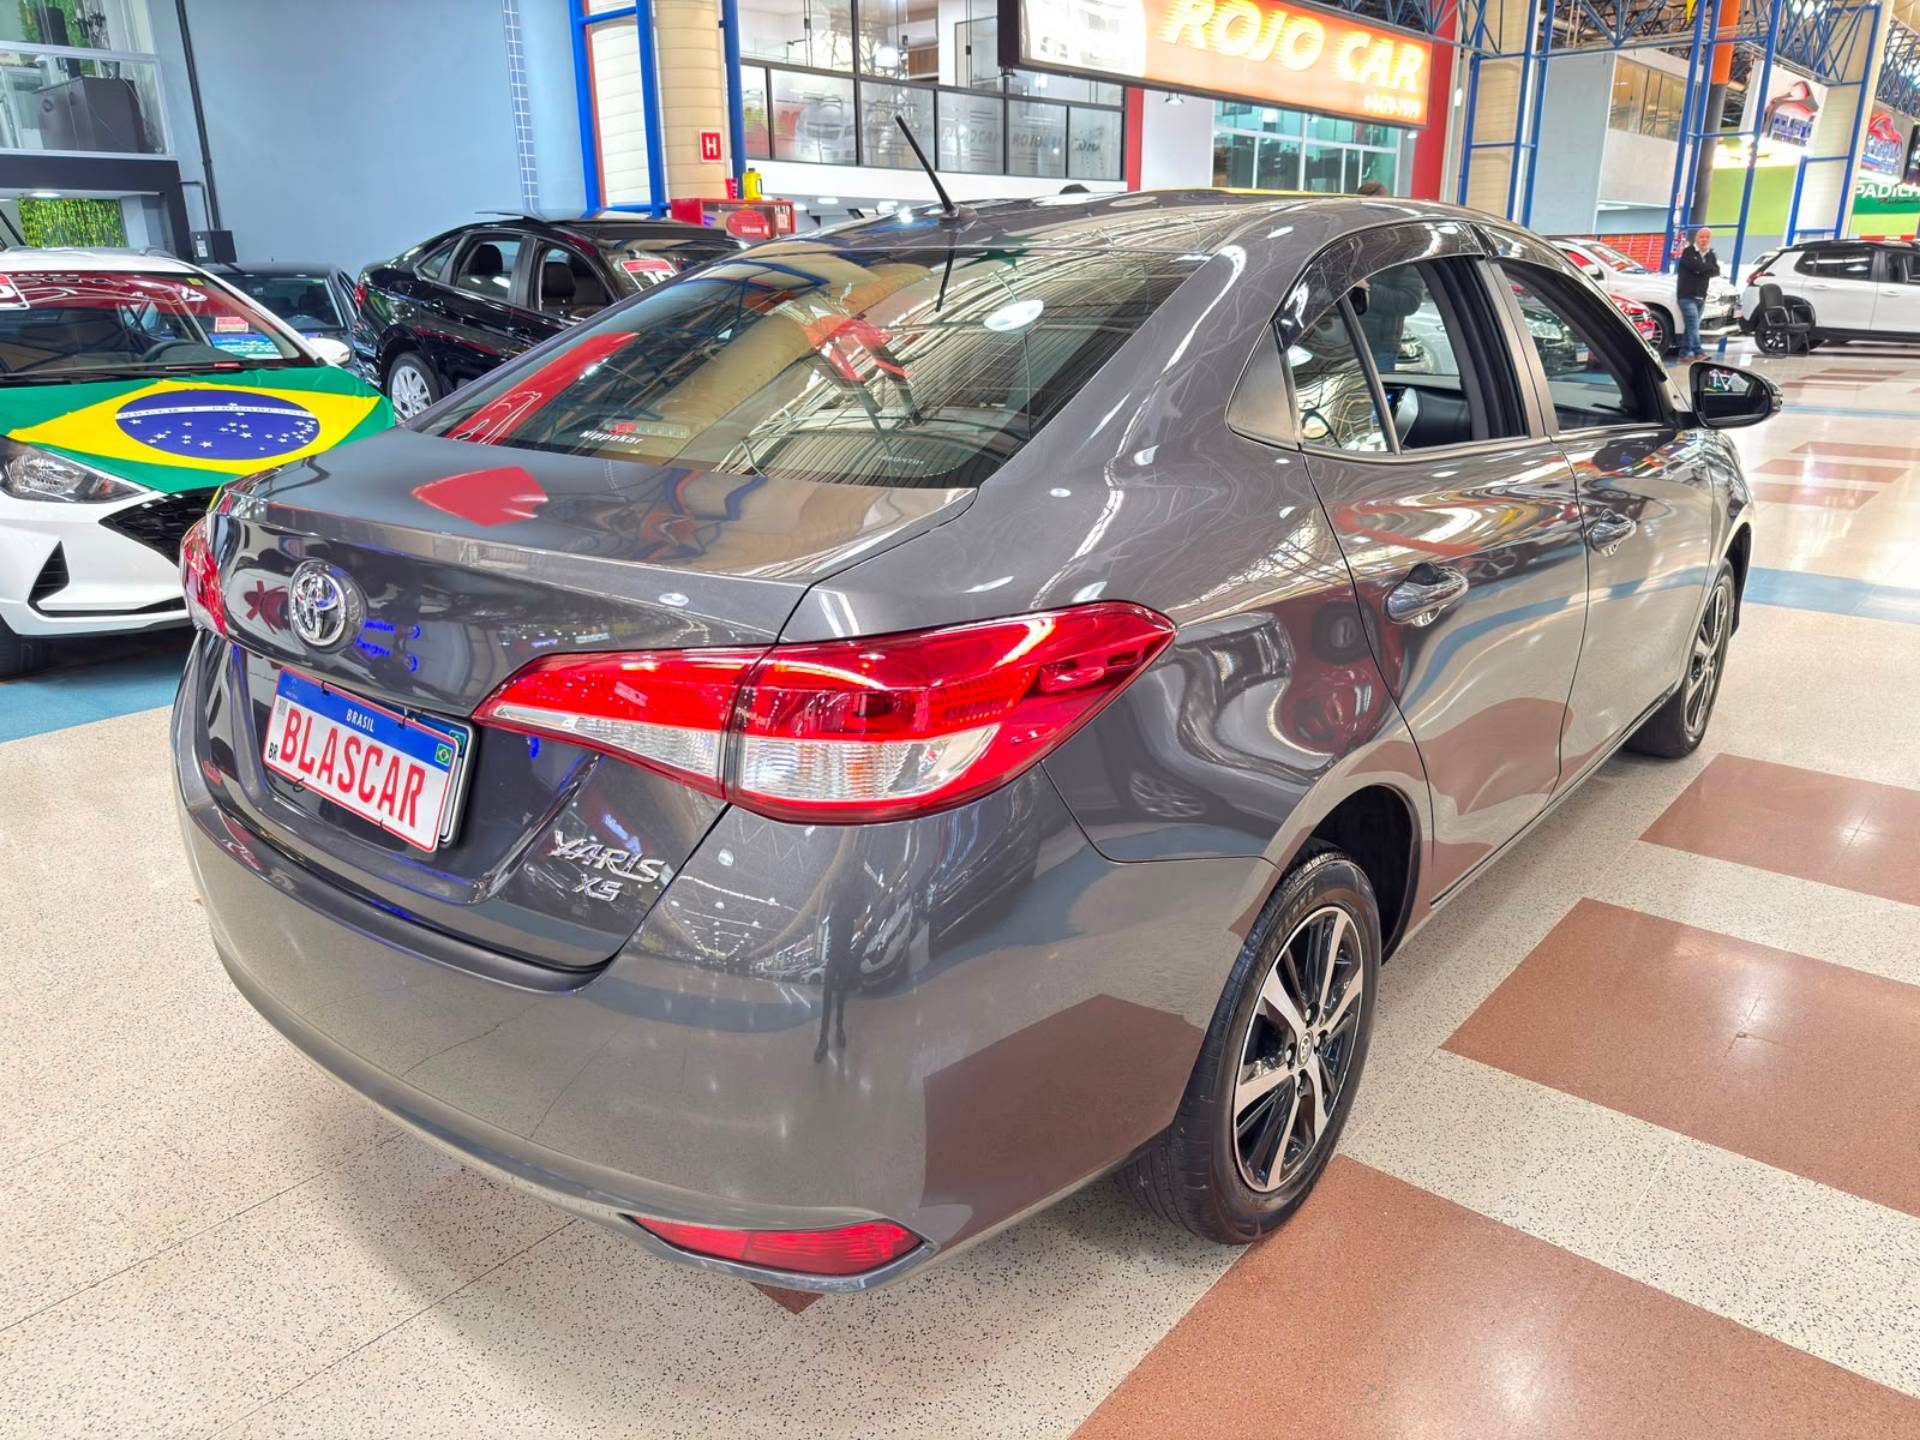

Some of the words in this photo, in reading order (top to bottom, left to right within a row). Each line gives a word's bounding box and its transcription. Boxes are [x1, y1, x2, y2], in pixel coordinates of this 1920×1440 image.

[1156, 0, 1326, 71] ROJO
[1332, 31, 1425, 93] CAR
[705, 135, 718, 156] H
[346, 708, 375, 733] BRASIL
[268, 742, 279, 761] BR
[279, 707, 426, 829] BLASCAR
[547, 830, 666, 883] YARIS
[571, 873, 624, 901] XS
